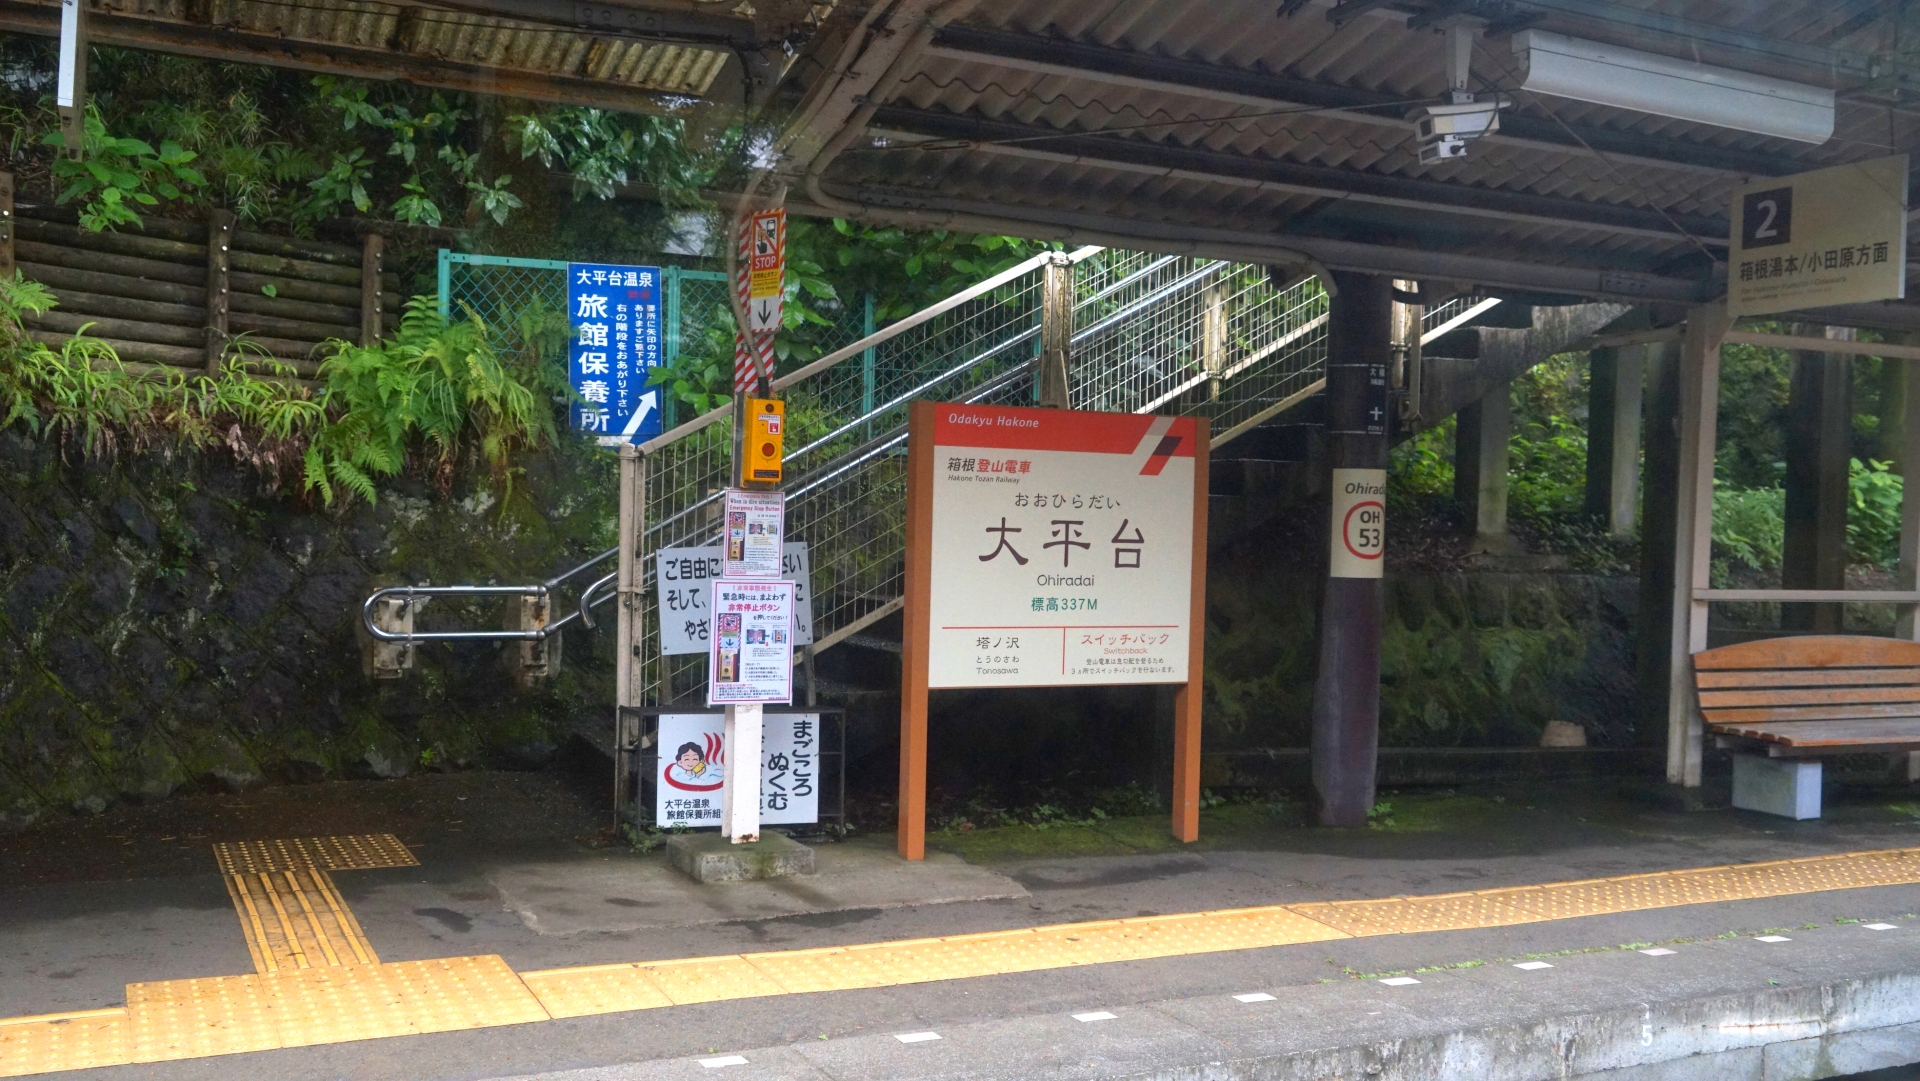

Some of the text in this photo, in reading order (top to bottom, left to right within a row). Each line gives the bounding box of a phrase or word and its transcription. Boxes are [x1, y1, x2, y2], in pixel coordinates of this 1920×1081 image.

[1754, 199, 1778, 239] 2
[755, 255, 777, 269] STOP
[1740, 241, 1889, 282] 箱根湯本/小田原方面
[576, 269, 653, 288] 大平台温泉
[634, 304, 645, 374] ありますご覧下さい
[646, 304, 657, 379] 要所に矢印の方向
[577, 293, 610, 432] 旅館保養所
[615, 304, 629, 417] 右の階段をおあがり下さい
[948, 413, 1040, 428] Odakyu Hakone
[947, 457, 1032, 474] 箱根登山電車
[948, 474, 973, 482] Hakone
[995, 476, 1020, 484] Railway
[1015, 492, 1121, 509] おおひらだい
[1360, 510, 1380, 524] OH
[978, 516, 1145, 569] 大平台
[1359, 528, 1380, 548] 53
[666, 557, 724, 581] ご自由に
[1037, 574, 1095, 587] Ohiradai
[666, 588, 706, 611] そして、
[722, 593, 786, 601] 緊急時には、まよわず
[1031, 596, 1098, 612] 標高337M
[728, 603, 780, 612] 非常停止ボタン
[684, 619, 711, 641] やさ
[976, 636, 1020, 649] 塔ノ沢
[1081, 633, 1170, 646] スイッチバック
[975, 655, 1020, 664] とうのさわ
[1103, 647, 1148, 655] Switchback
[975, 666, 1019, 675] Tonosawa
[791, 720, 814, 797] まごころ
[767, 752, 789, 811] ぬくむ
[665, 798, 710, 809] 大平台温泉
[667, 808, 723, 820] 旅館保養所組
[1640, 1024, 1653, 1047] 5
